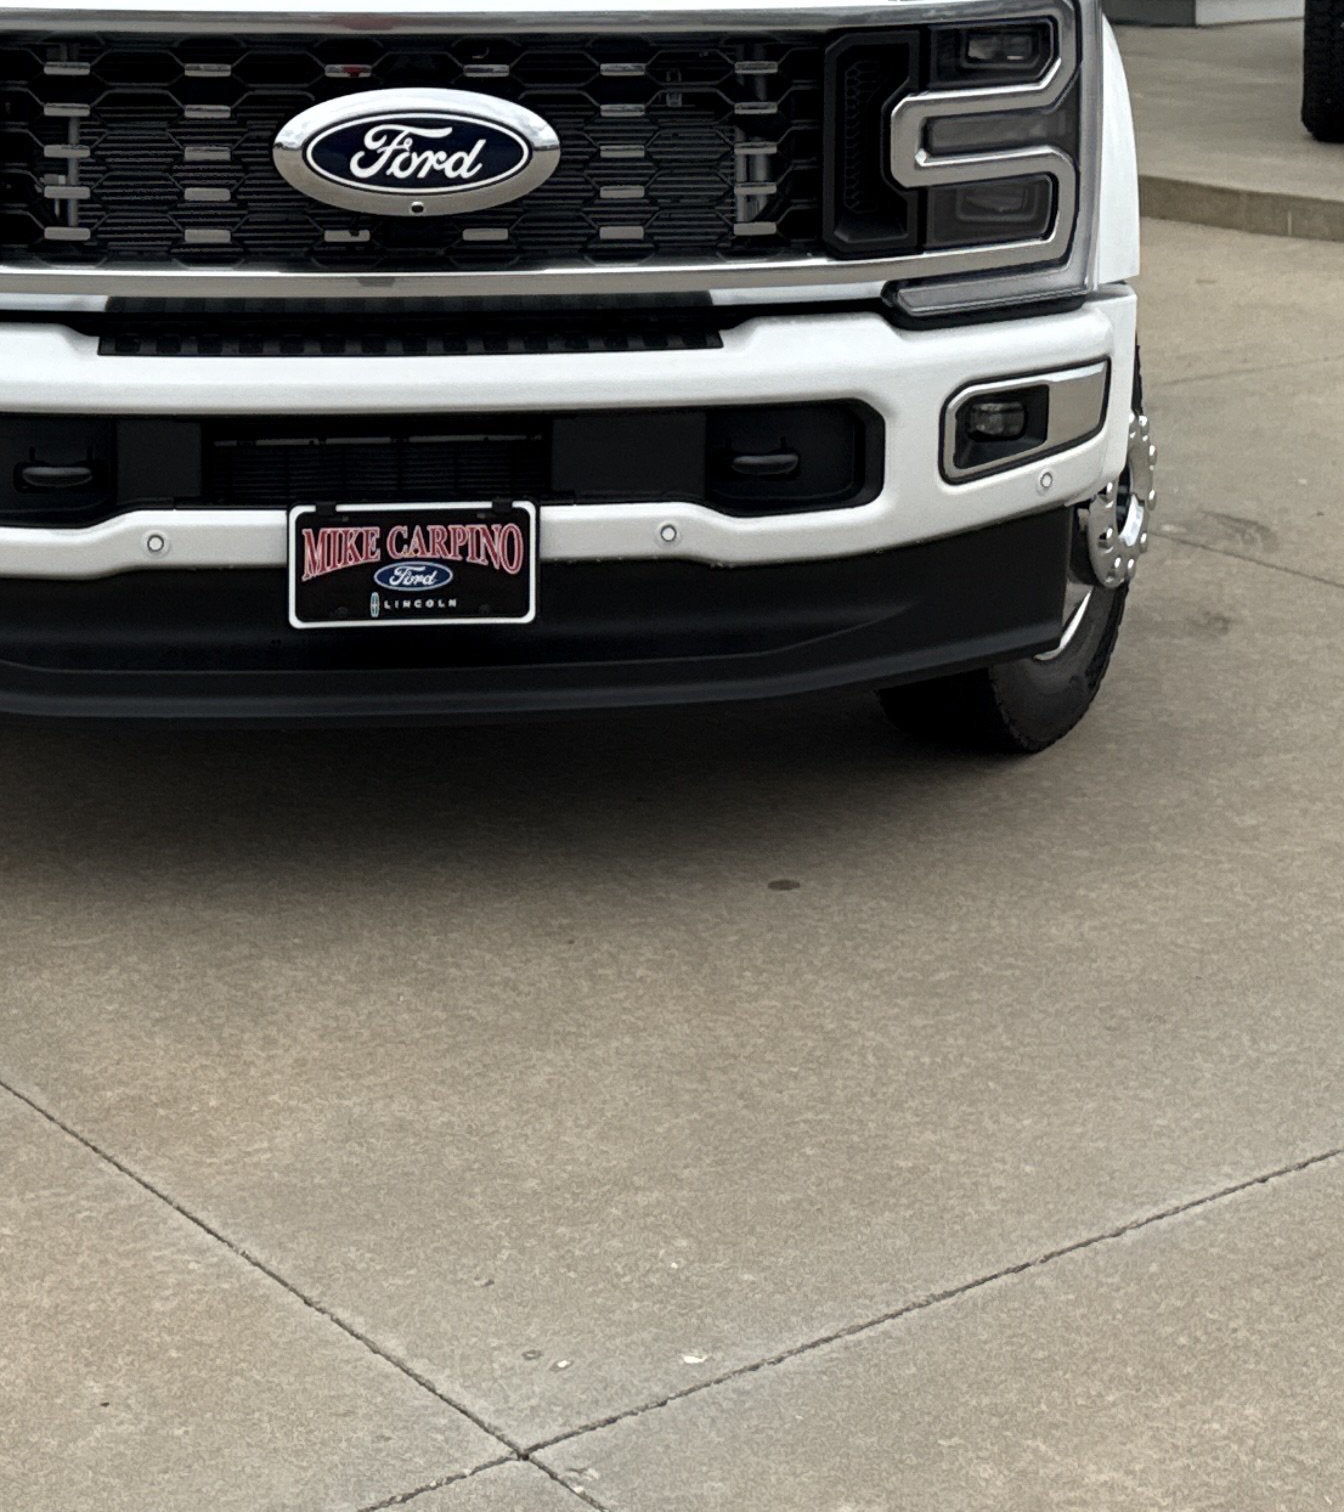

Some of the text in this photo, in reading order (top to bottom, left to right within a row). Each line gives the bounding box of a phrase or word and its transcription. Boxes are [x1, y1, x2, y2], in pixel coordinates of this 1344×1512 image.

[349, 123, 487, 180] Ford
[301, 522, 524, 582] MIKE CARPINO
[389, 565, 438, 586] Ford
[383, 598, 457, 609] LINCOLN
